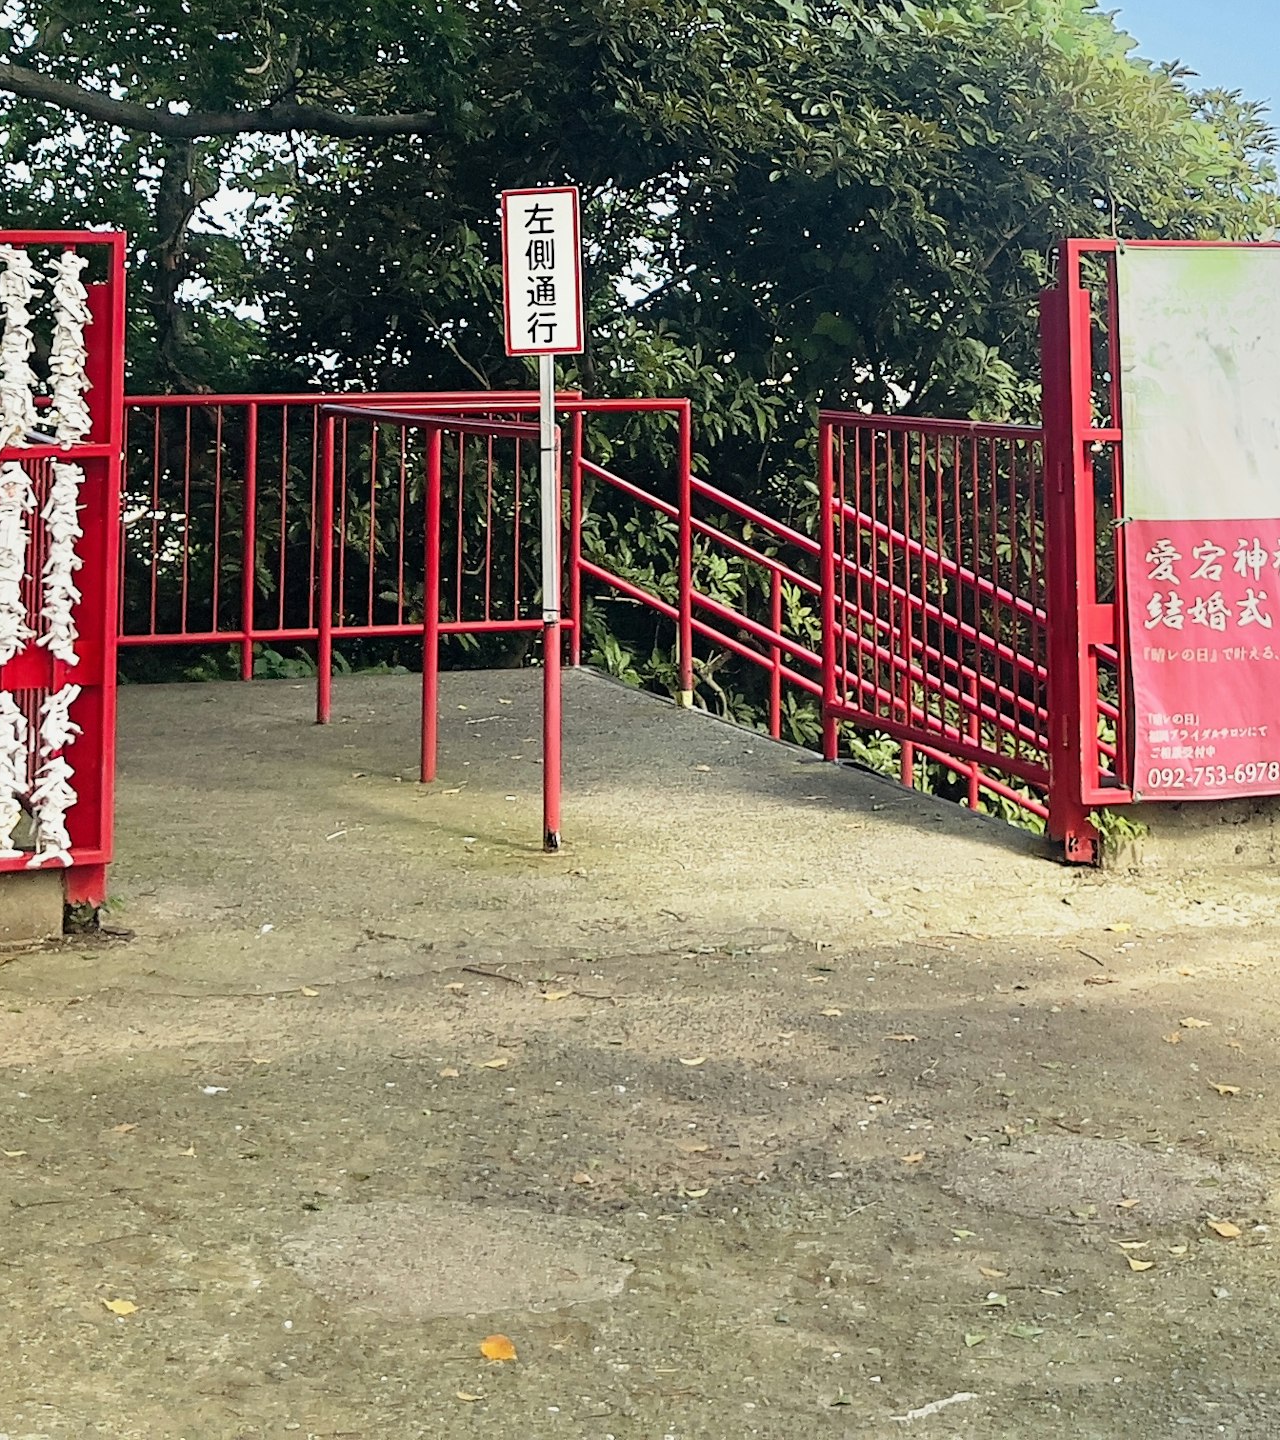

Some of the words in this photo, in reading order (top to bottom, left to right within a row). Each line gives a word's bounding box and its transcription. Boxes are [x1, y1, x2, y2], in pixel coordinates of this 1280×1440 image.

[523, 202, 558, 344] 左側通行
[1143, 587, 1273, 632] 結婚式
[1147, 761, 1280, 788] 092-753-6978
